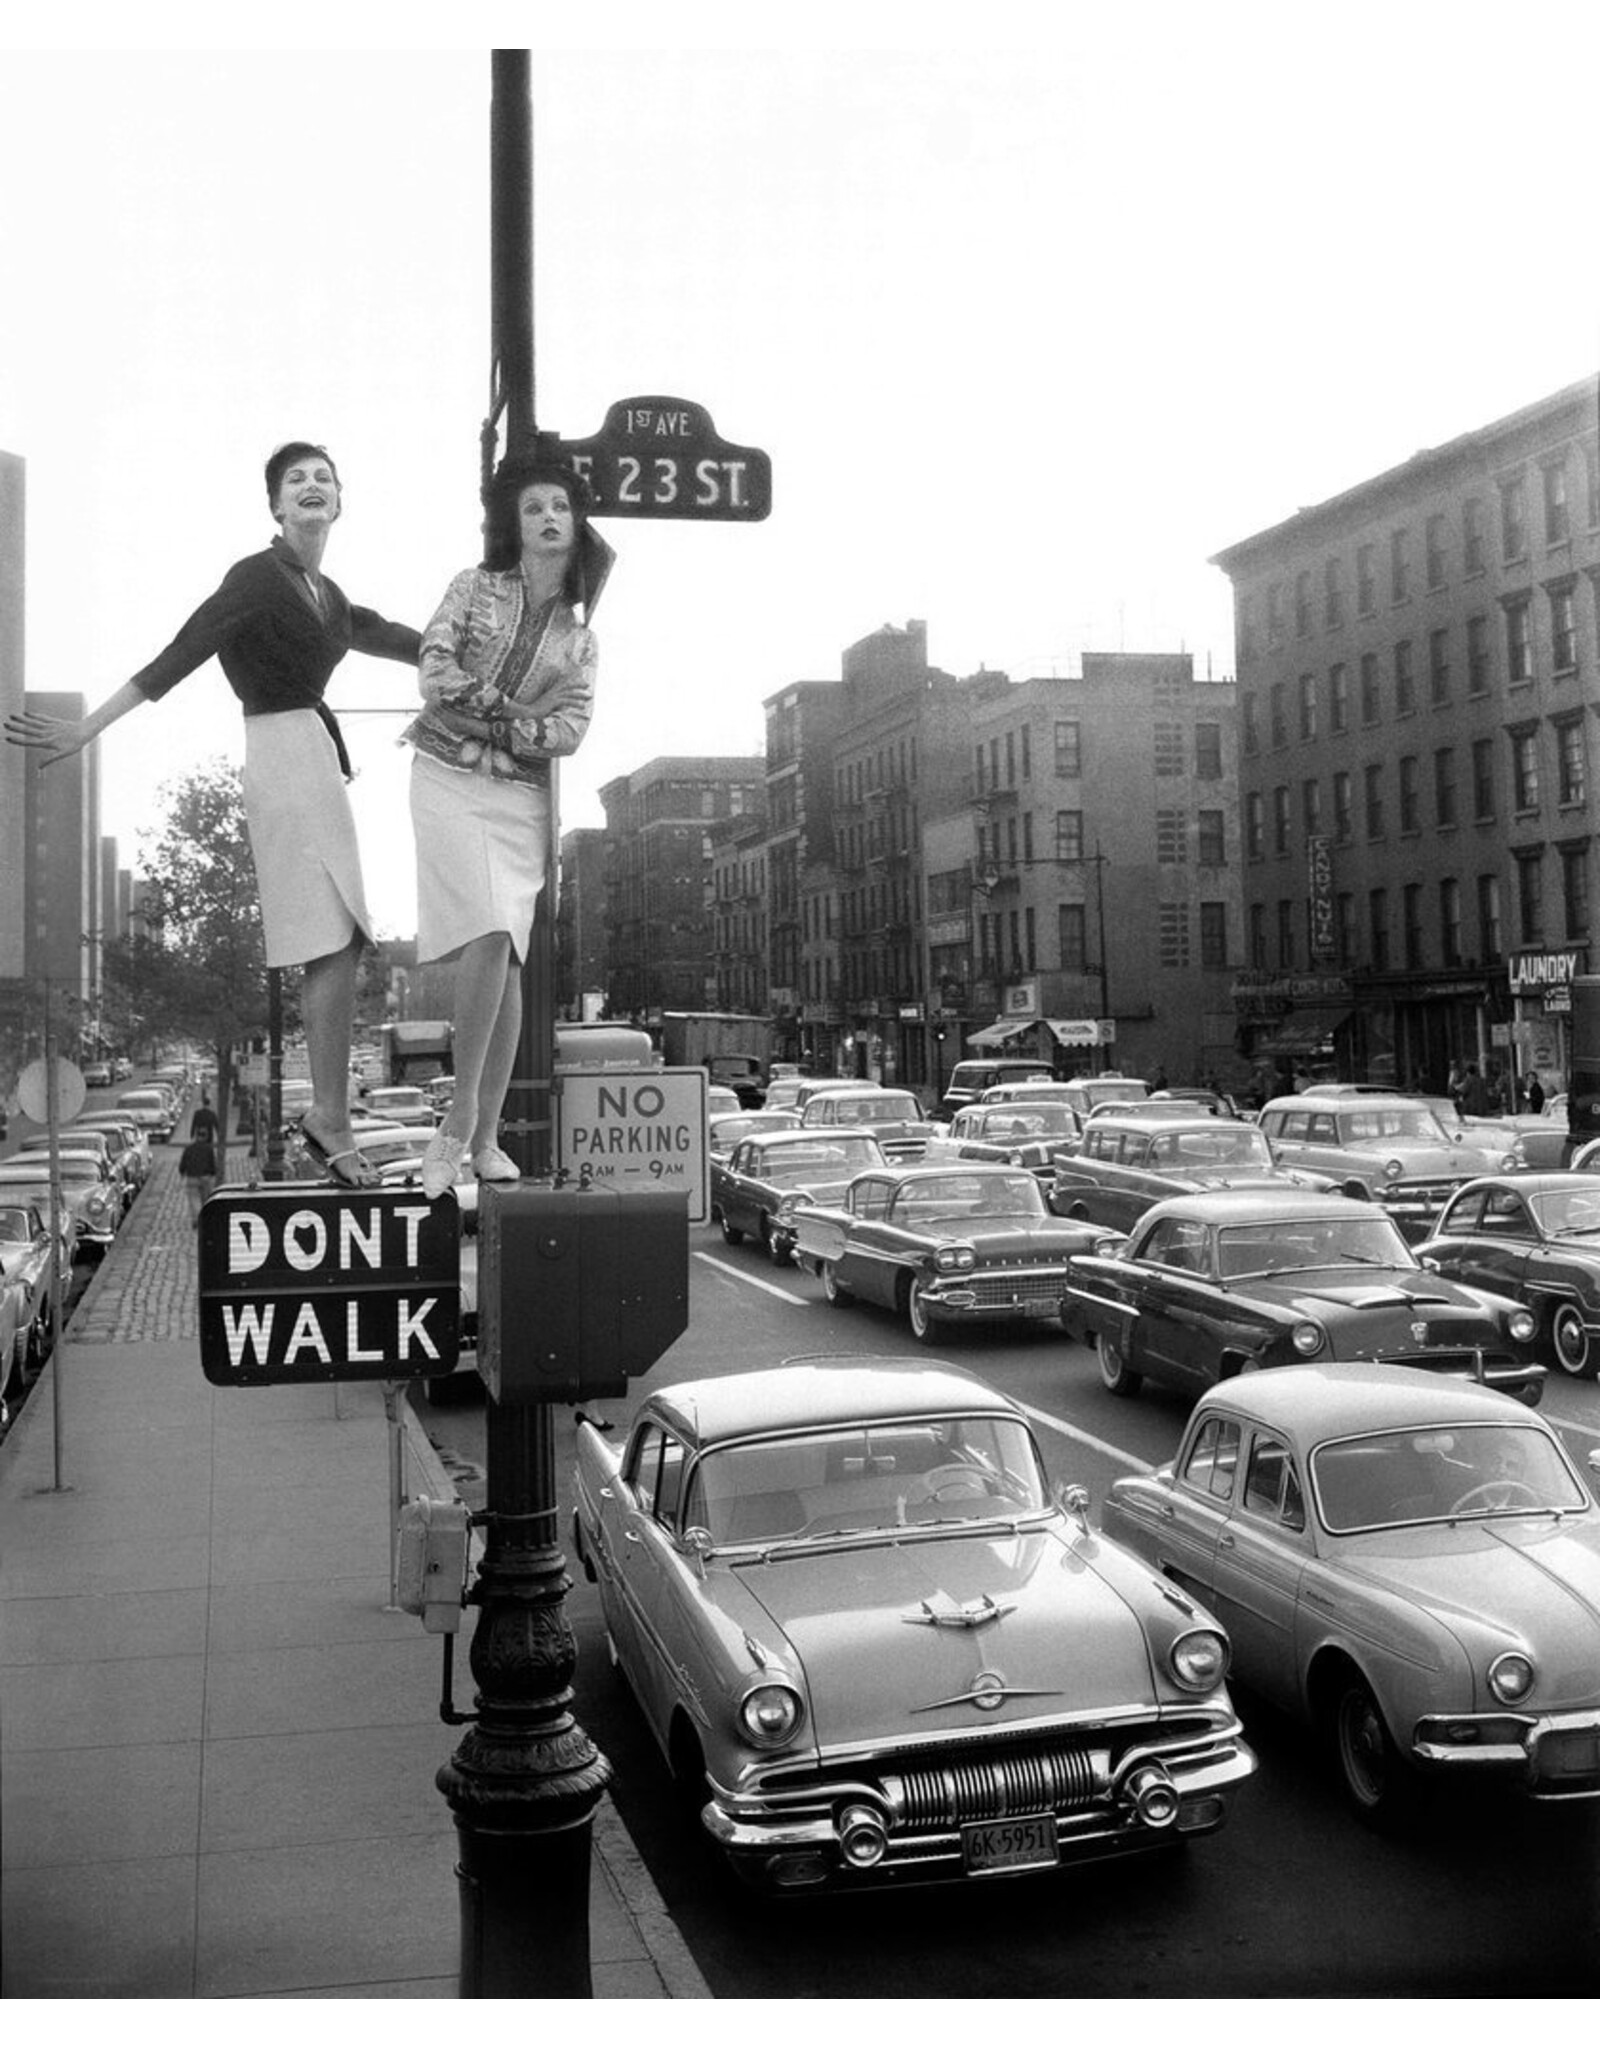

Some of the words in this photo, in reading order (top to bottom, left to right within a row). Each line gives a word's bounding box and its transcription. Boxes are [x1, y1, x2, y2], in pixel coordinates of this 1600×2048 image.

[618, 455, 678, 503] 23
[695, 459, 749, 507] ST.
[1509, 953, 1577, 985] LAUNDRY
[598, 1085, 665, 1118] NO
[573, 1125, 690, 1154] PARKING
[649, 1160, 684, 1179] 9AM
[229, 1206, 431, 1274] DONT
[222, 1298, 441, 1366] WALK
